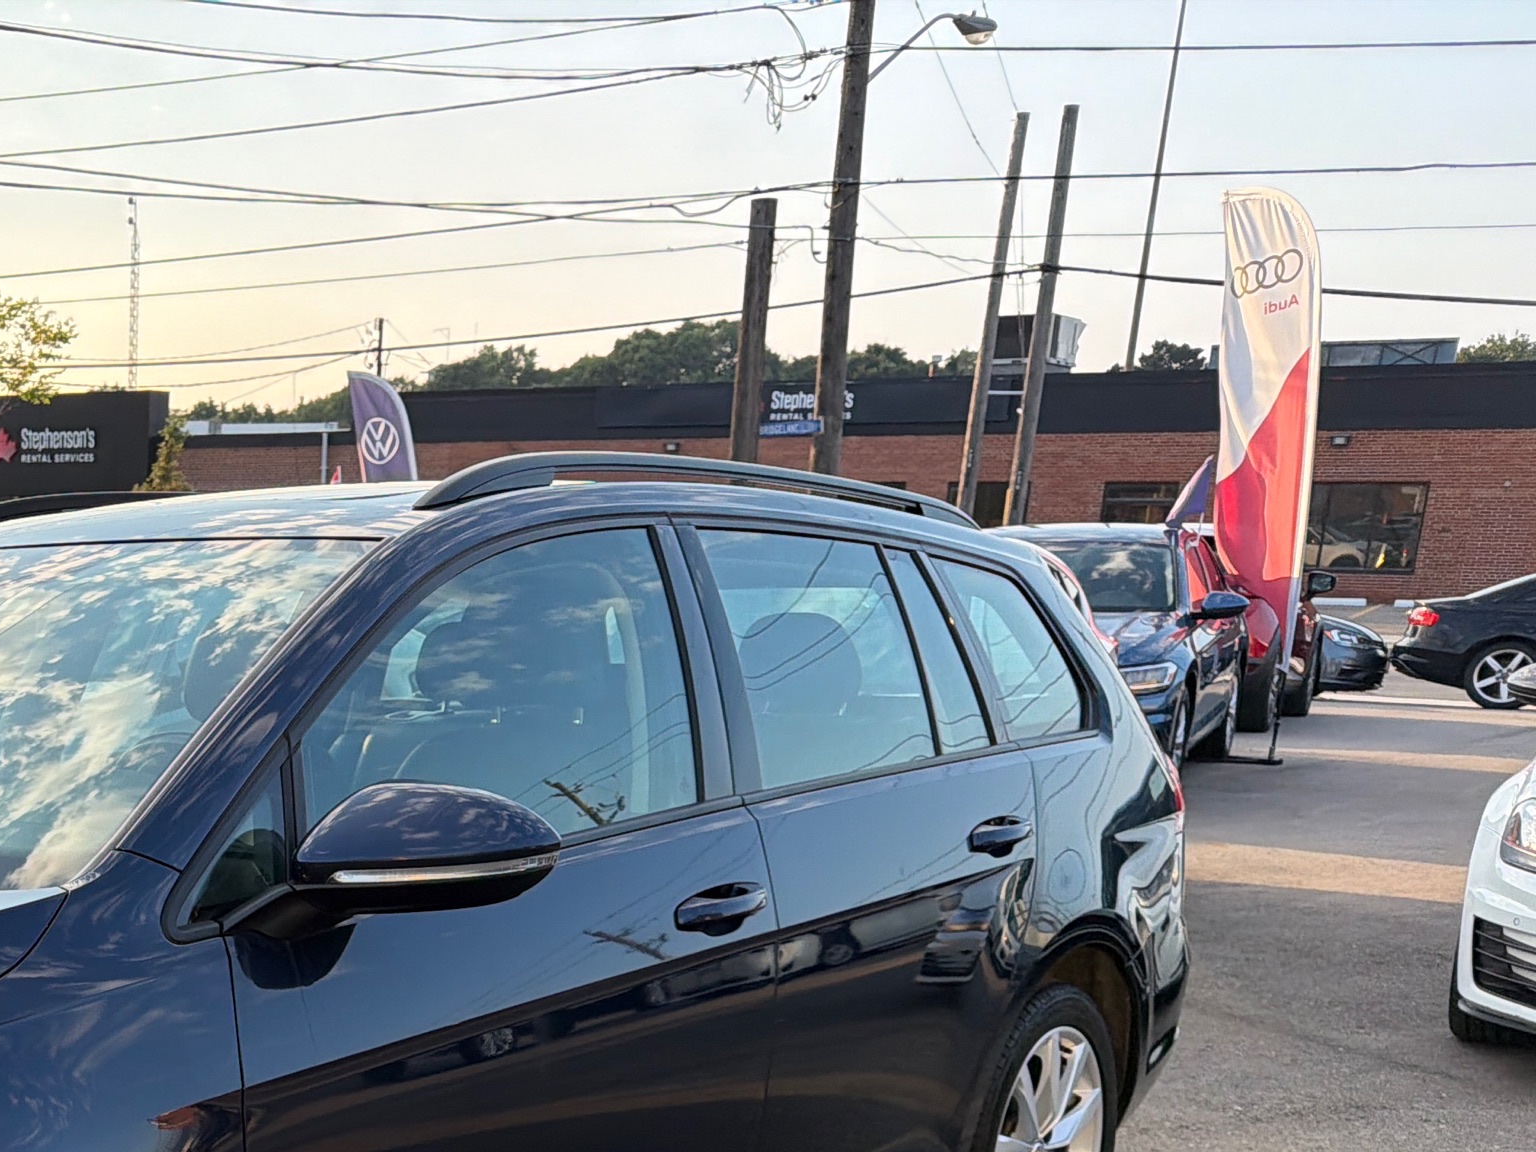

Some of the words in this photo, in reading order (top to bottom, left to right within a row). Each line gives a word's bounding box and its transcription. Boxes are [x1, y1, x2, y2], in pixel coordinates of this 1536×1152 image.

[771, 391, 855, 411] Stephe's
[21, 428, 95, 451] Stephenson's
[21, 453, 52, 463] RENTAL
[54, 453, 94, 463] SERVICES
